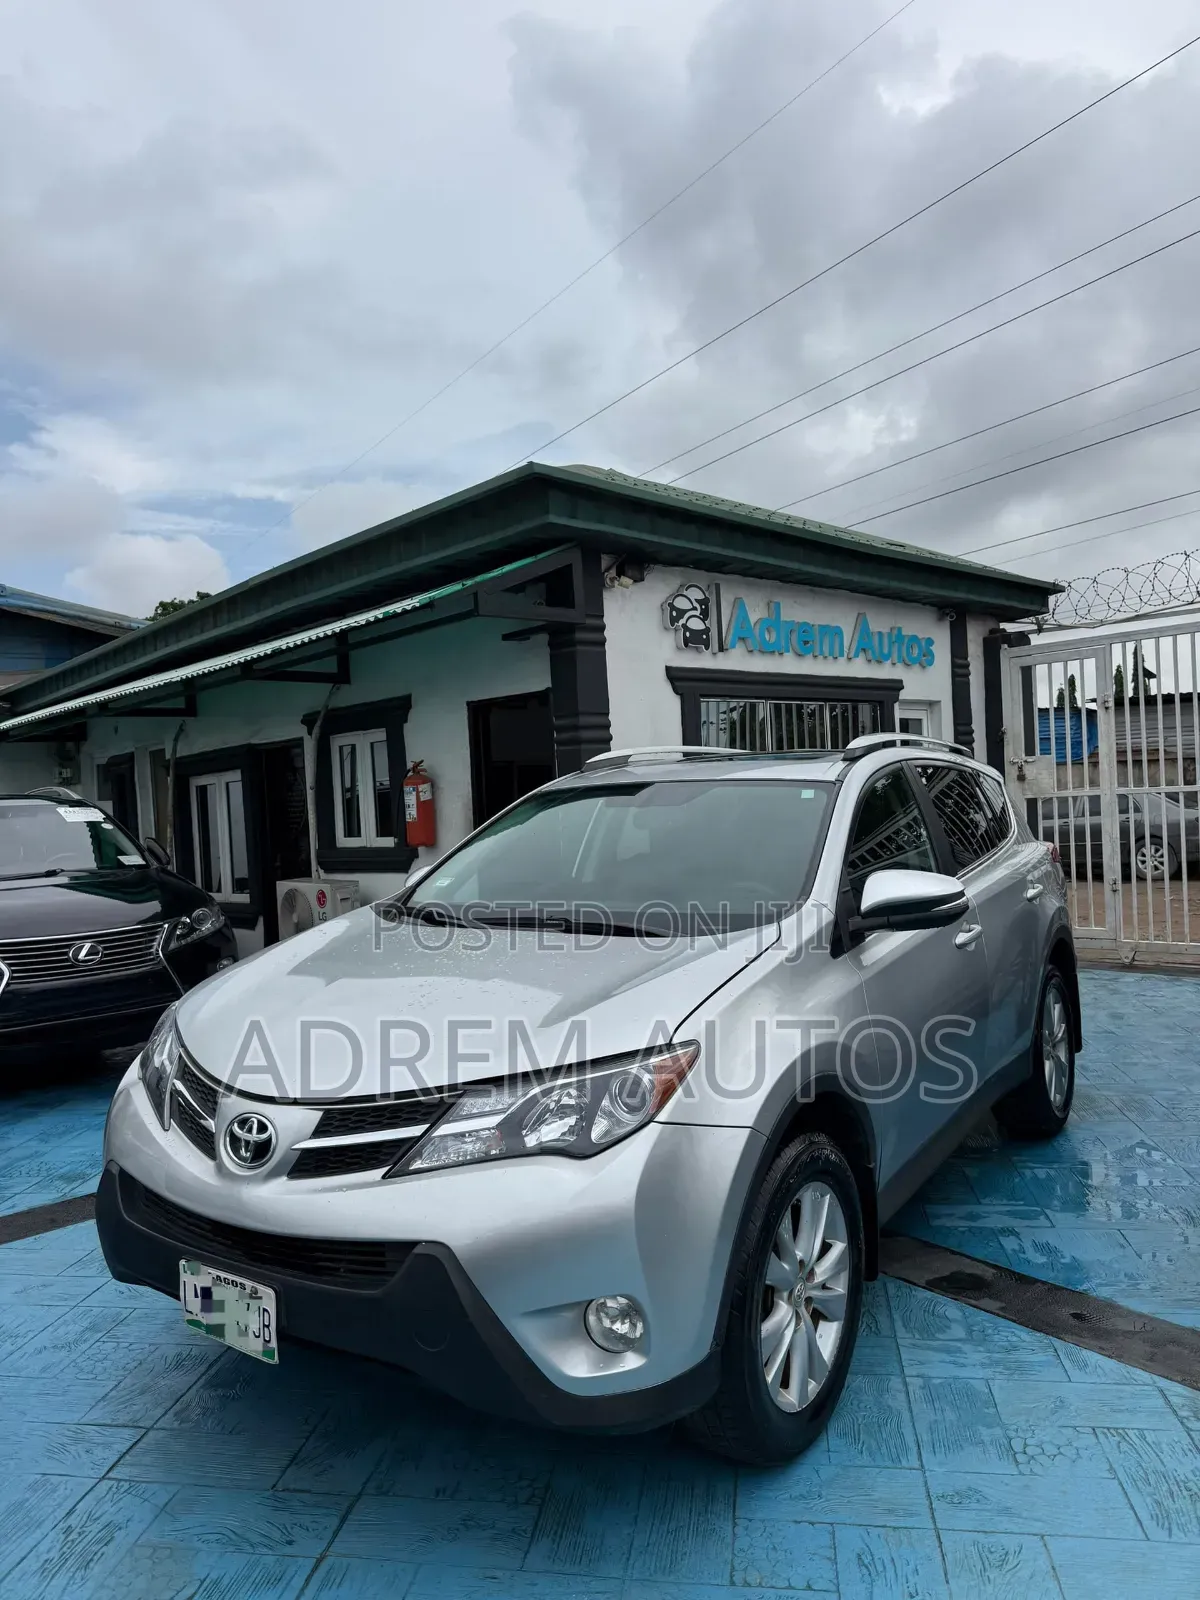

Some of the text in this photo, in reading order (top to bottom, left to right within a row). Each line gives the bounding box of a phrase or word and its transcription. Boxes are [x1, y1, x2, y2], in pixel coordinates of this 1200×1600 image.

[726, 597, 935, 668] Adrem Autos
[318, 911, 327, 921] LG
[211, 1274, 247, 1291] AGOS
